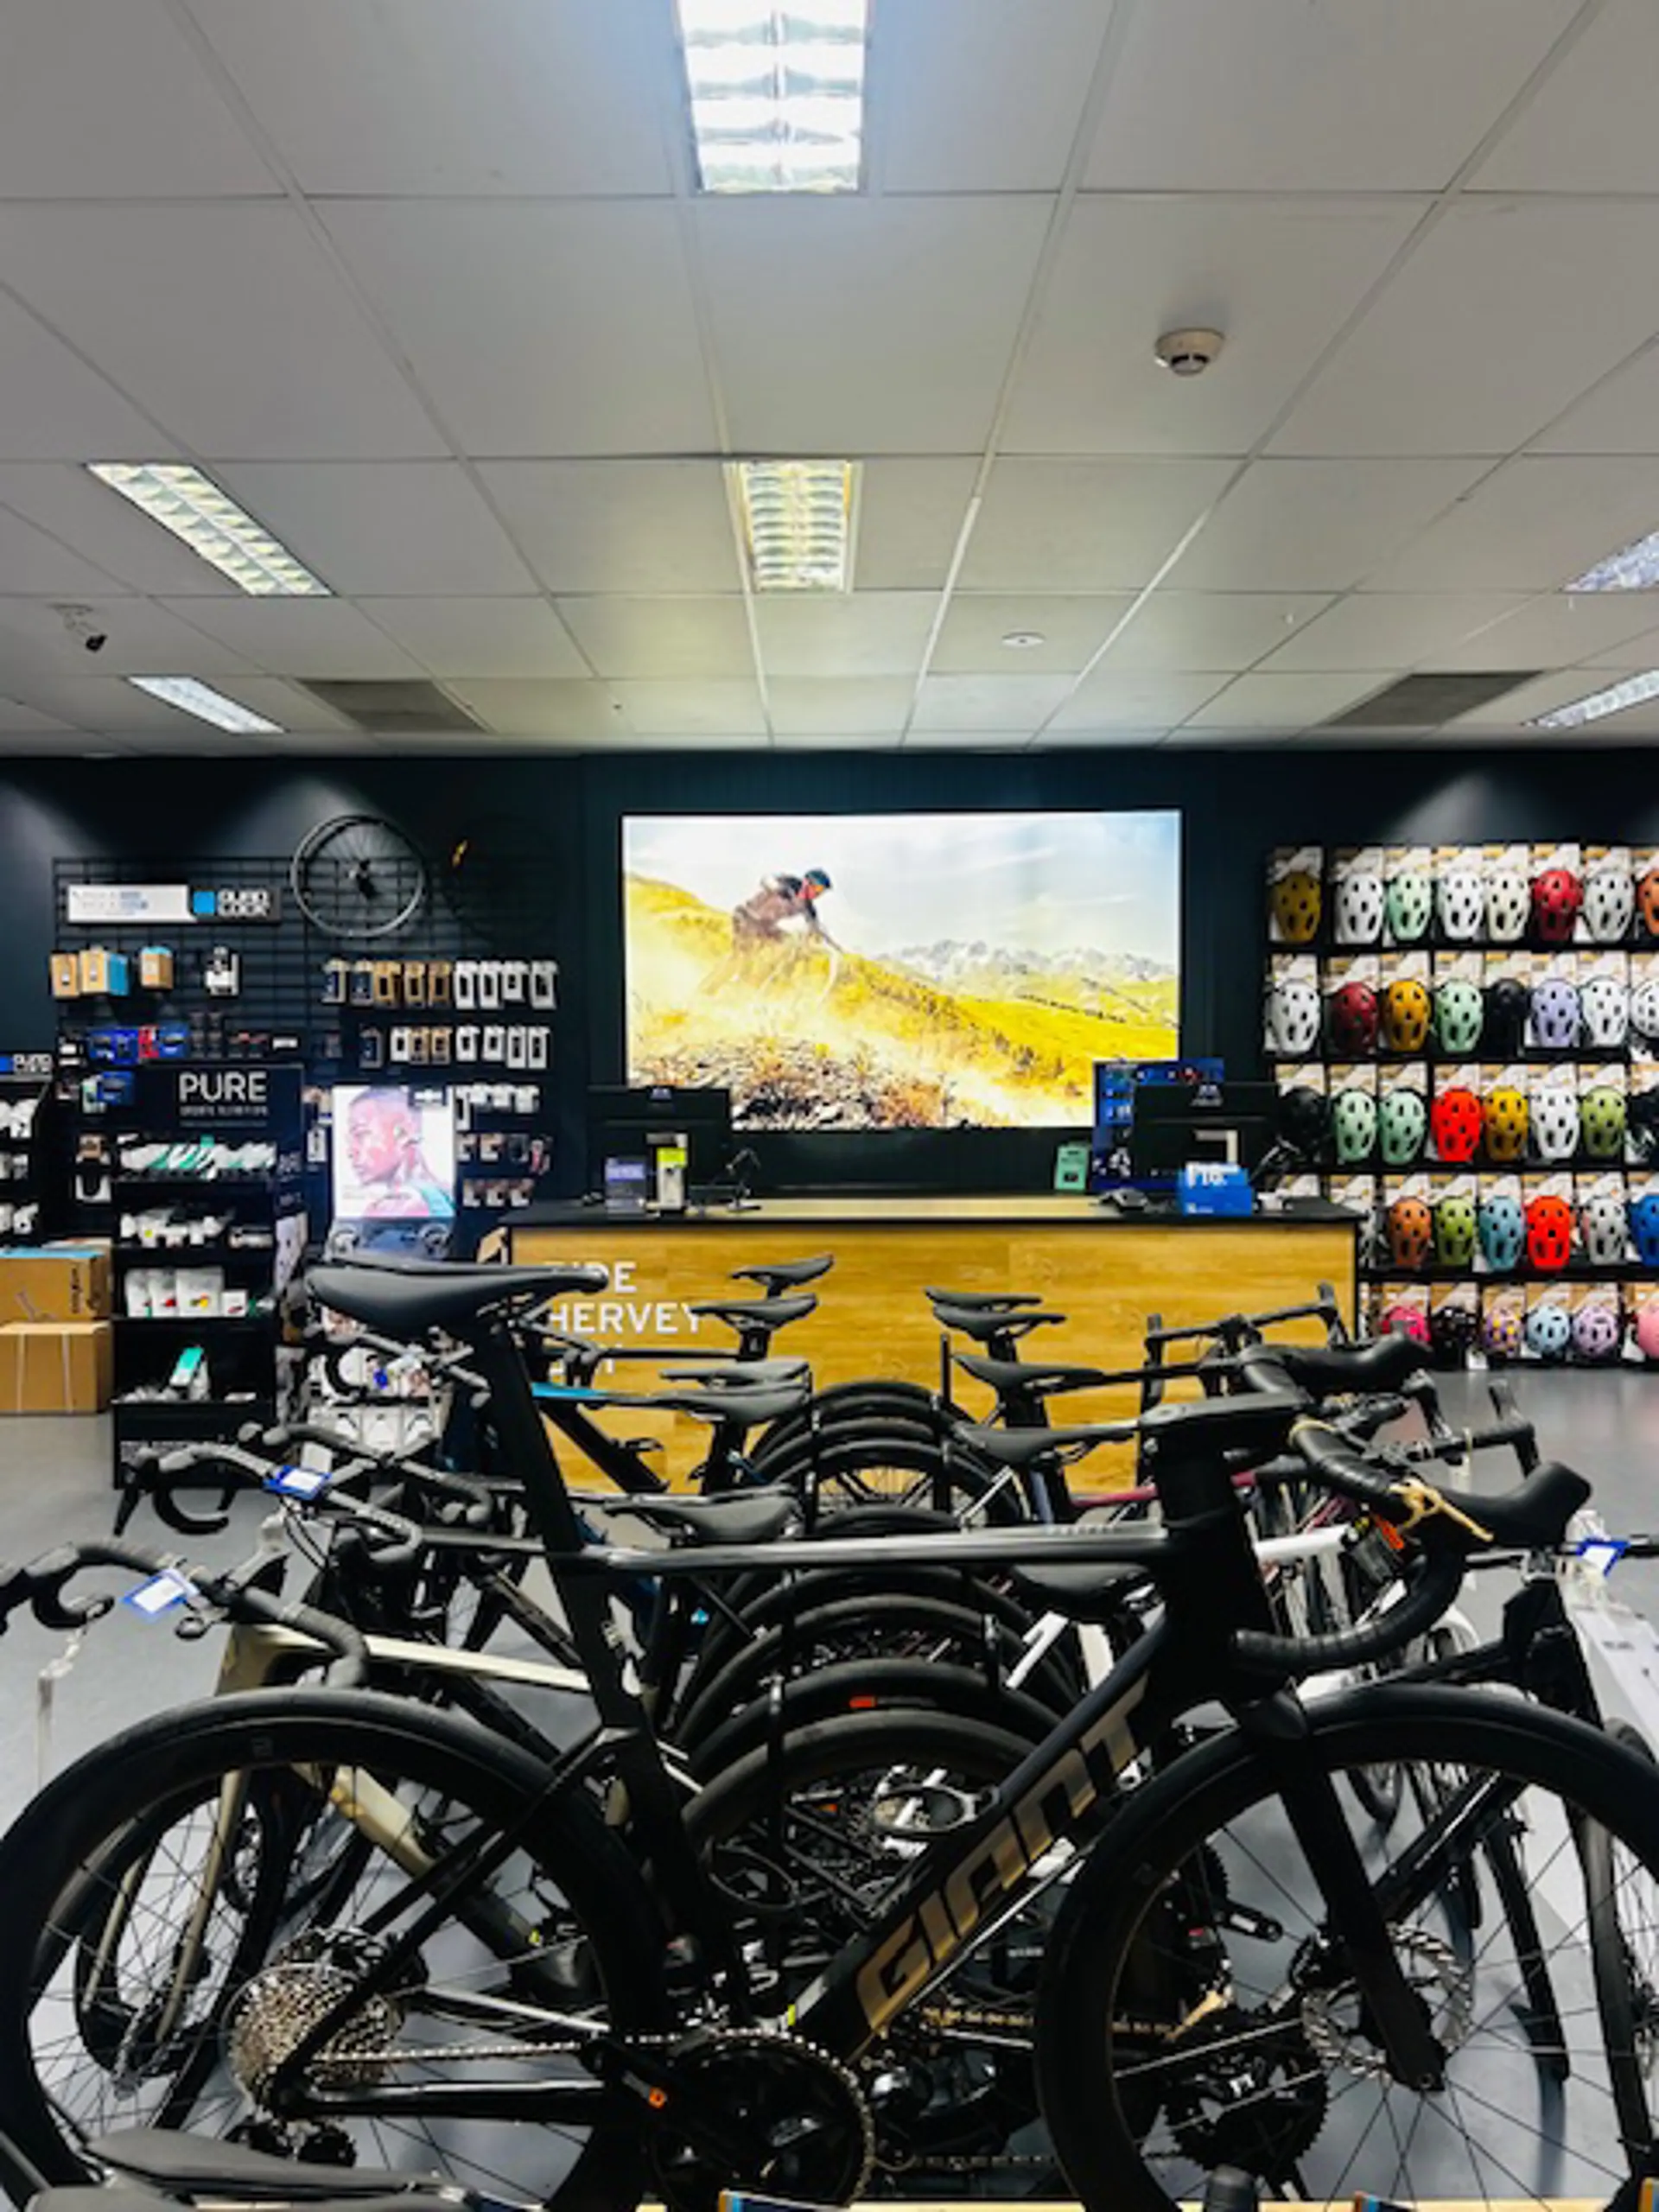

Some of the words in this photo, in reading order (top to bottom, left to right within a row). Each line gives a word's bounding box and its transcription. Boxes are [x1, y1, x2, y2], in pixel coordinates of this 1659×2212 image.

[179, 1071, 267, 1103] PURE
[548, 1301, 701, 1334] HERVEY
[856, 1671, 1149, 2033] GIANT
